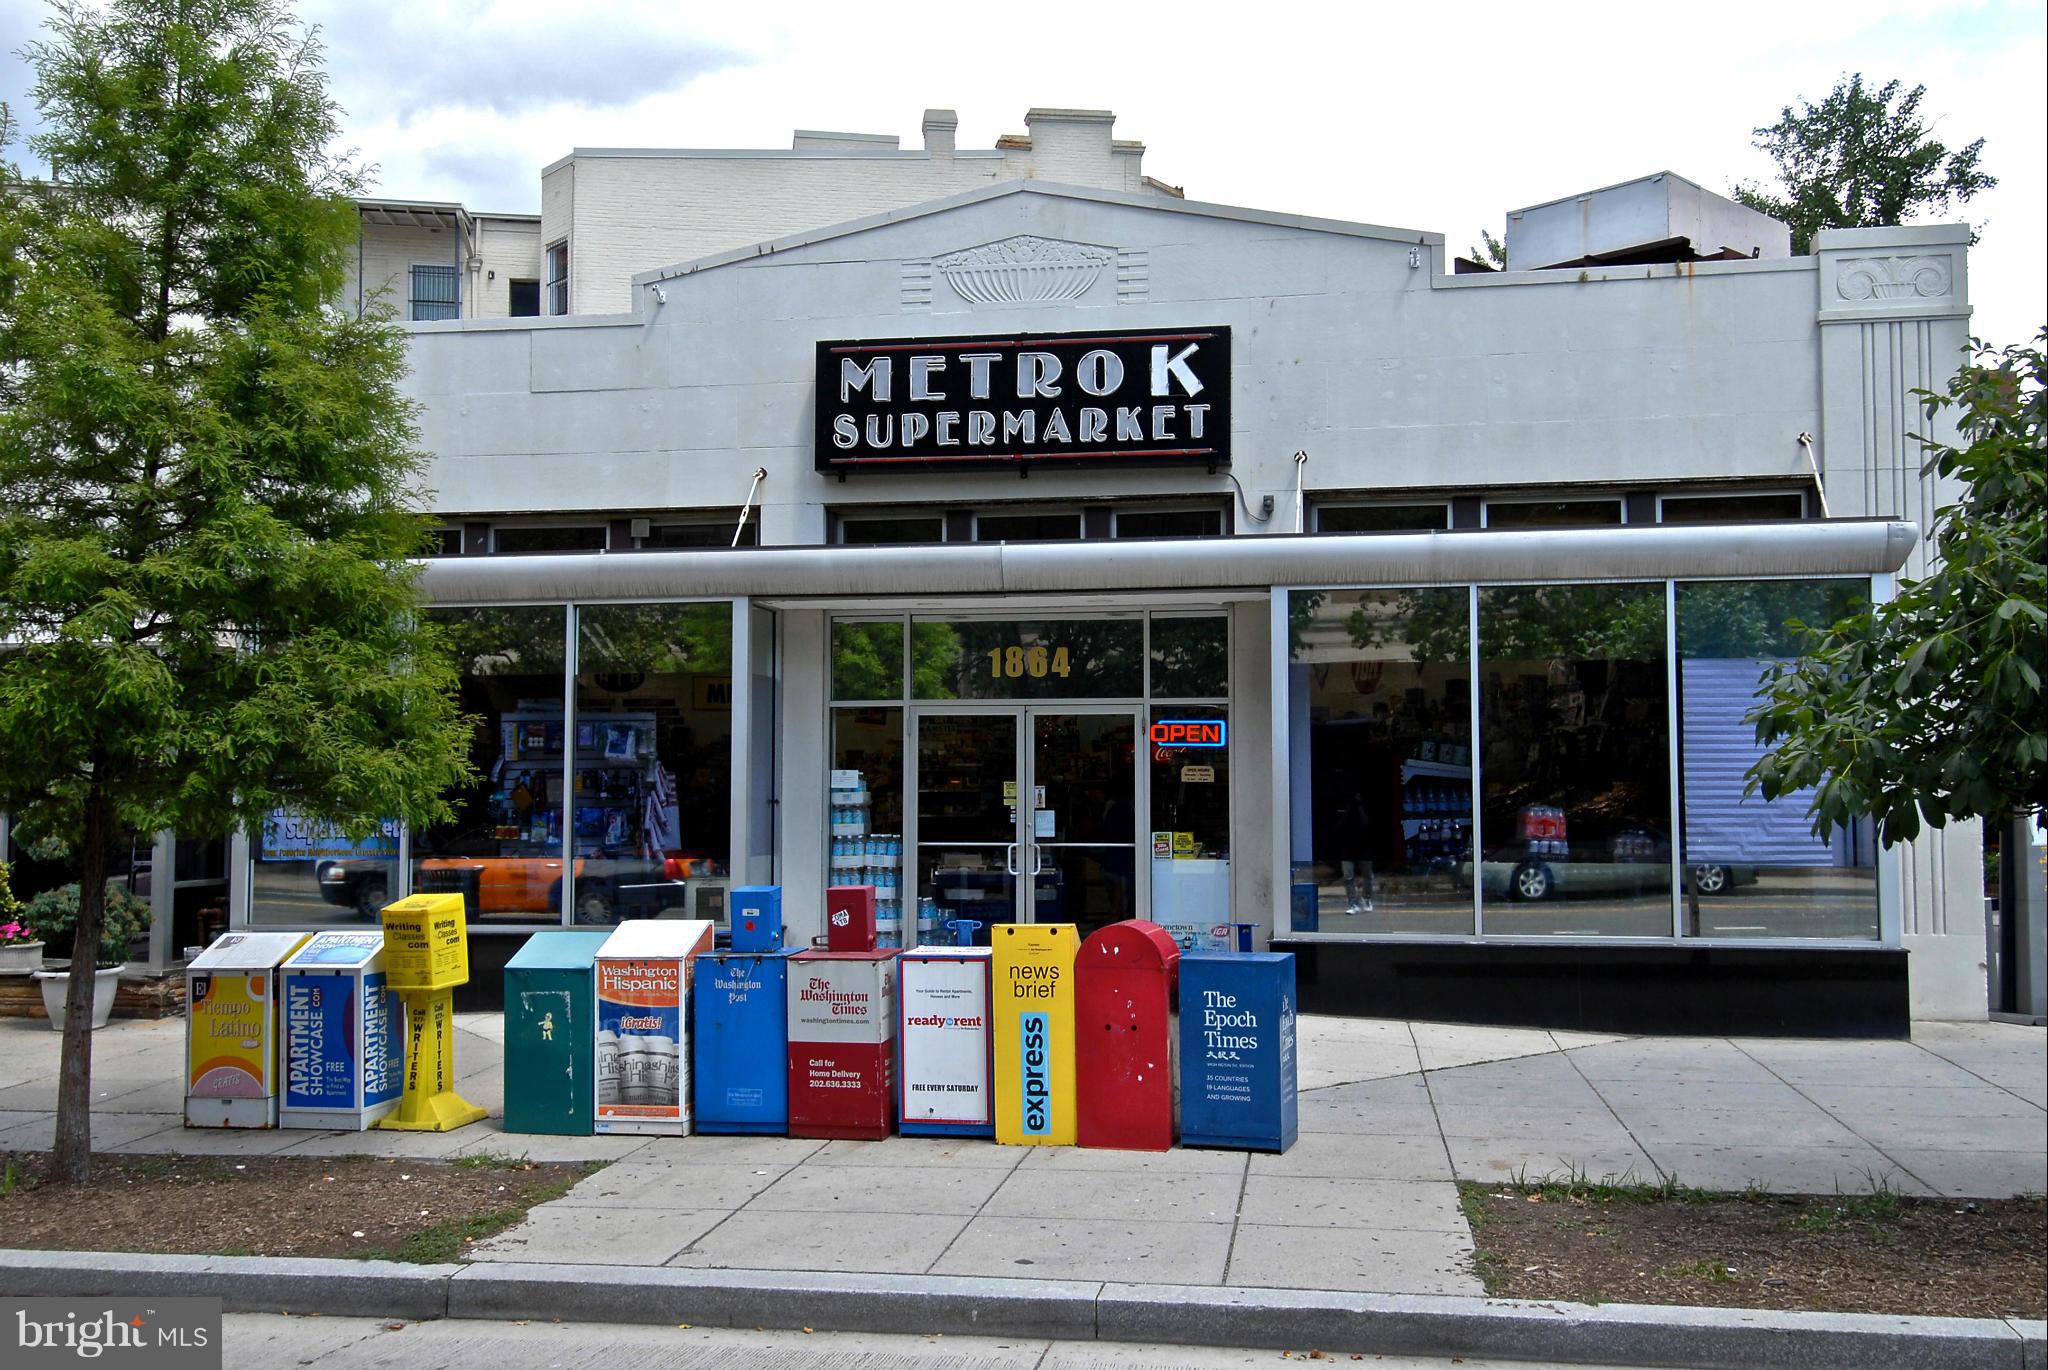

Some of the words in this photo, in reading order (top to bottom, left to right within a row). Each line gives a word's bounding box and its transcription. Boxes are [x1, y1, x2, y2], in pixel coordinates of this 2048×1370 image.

[841, 348, 1125, 403] METRO
[1150, 342, 1205, 397] K
[833, 403, 1211, 449] SUPERMARKET
[987, 646, 1071, 678] 1864
[1150, 724, 1219, 743] OPEN
[385, 923, 421, 932] Writing
[434, 919, 455, 930] Writing
[393, 933, 425, 941] Classes
[438, 929, 457, 939] Classes
[602, 965, 677, 978] Washington
[730, 968, 745, 978] The
[1010, 966, 1060, 980] news
[196, 982, 206, 995] El
[604, 976, 677, 991] Hispanic
[715, 978, 761, 991] Washington
[809, 977, 830, 991] The
[1014, 981, 1056, 998] brief
[729, 992, 747, 1005] Post
[801, 989, 869, 1005] Washington
[1203, 991, 1237, 1008] The
[200, 999, 250, 1017] Tiempo
[832, 1002, 867, 1015] Times
[801, 1017, 869, 1025] washingtontimes.com
[1204, 1010, 1258, 1030] Epoch
[209, 1018, 261, 1038] Latino
[290, 985, 309, 1095] APARTMENT
[364, 985, 378, 1093] APARTMENT
[1204, 1031, 1258, 1049] Times
[409, 1023, 423, 1090] WRITERS
[809, 1059, 824, 1067] Call
[824, 1059, 835, 1067] for
[326, 1062, 344, 1072] FREE
[832, 1070, 861, 1079] Delivery
[1025, 1017, 1048, 1132] express
[912, 1084, 926, 1092] FREE
[926, 1084, 945, 1092] EVERY
[946, 1084, 978, 1092] SATURDAY
[1213, 1084, 1250, 1092] LANGUAGES
[1220, 1094, 1251, 1102] GROWING
